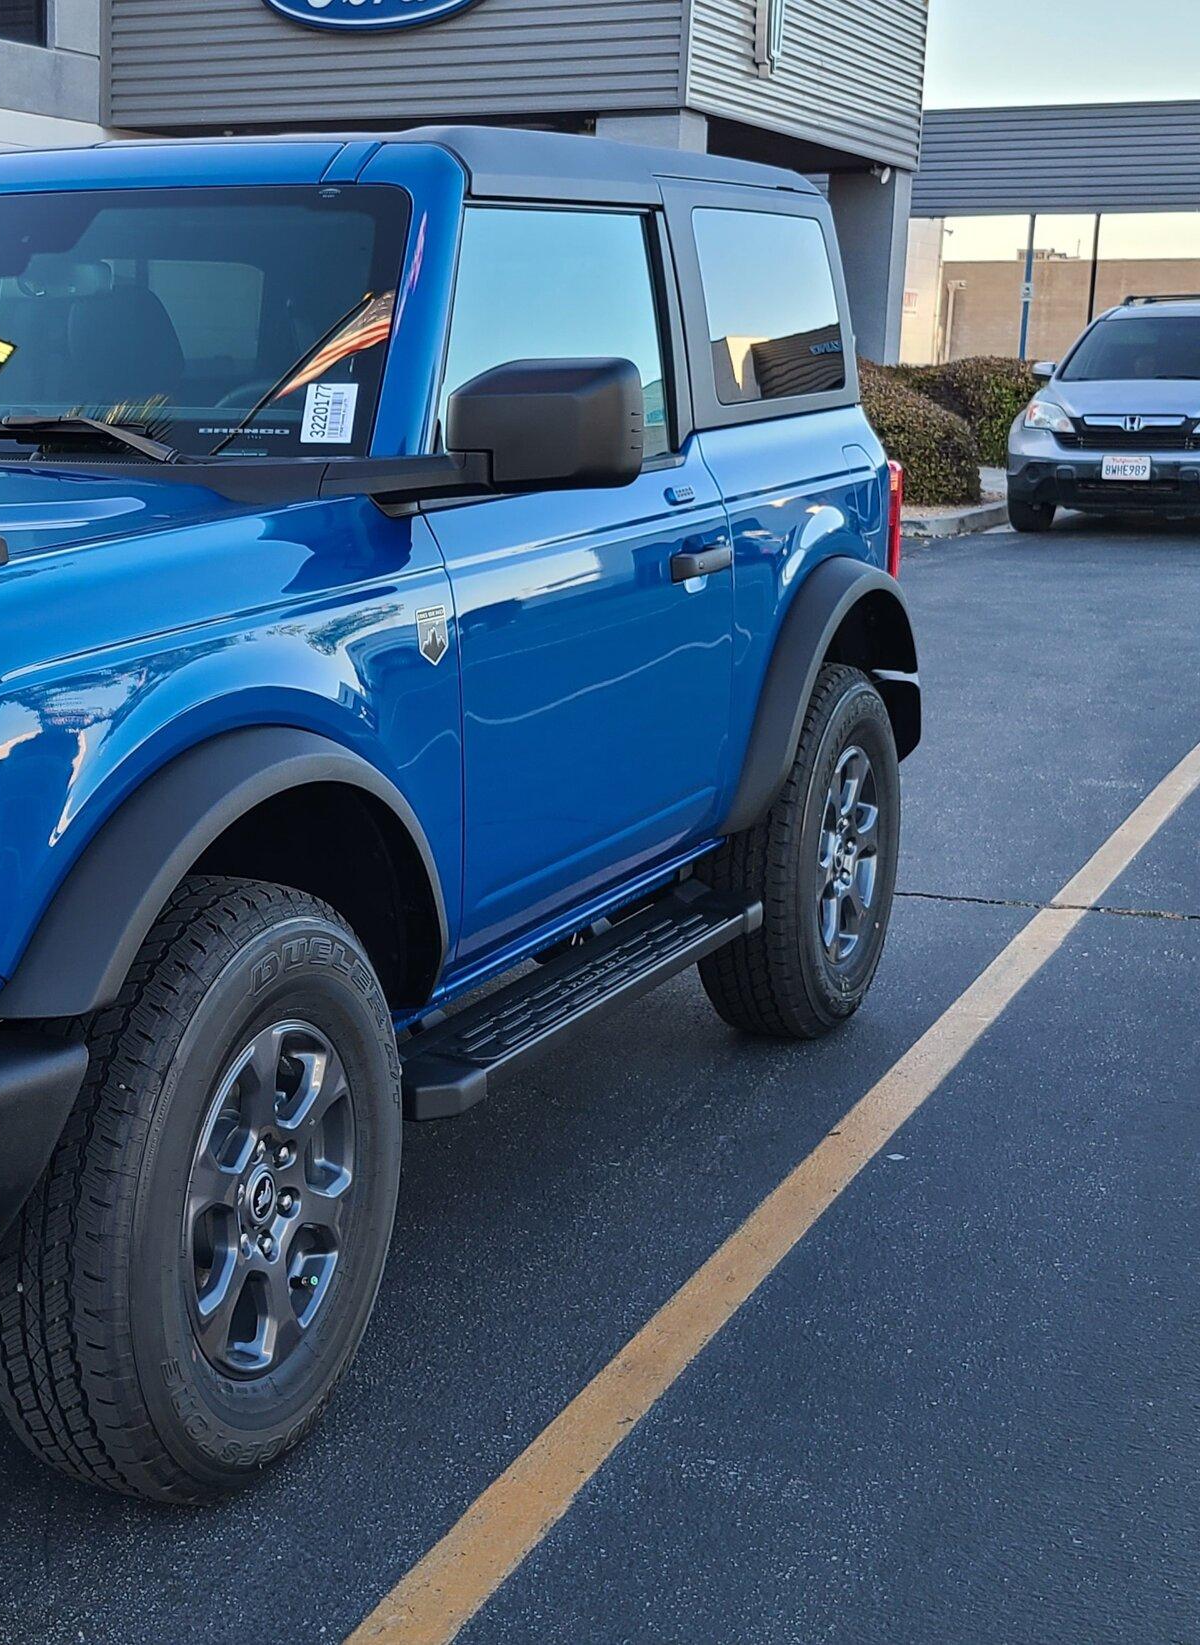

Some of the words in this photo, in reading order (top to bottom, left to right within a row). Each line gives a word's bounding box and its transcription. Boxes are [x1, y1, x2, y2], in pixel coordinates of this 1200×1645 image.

[198, 427, 290, 435] BRONCO
[309, 384, 332, 438] 3220177
[250, 936, 387, 1032] DUELER
[161, 1352, 350, 1467] IDGESTONE
